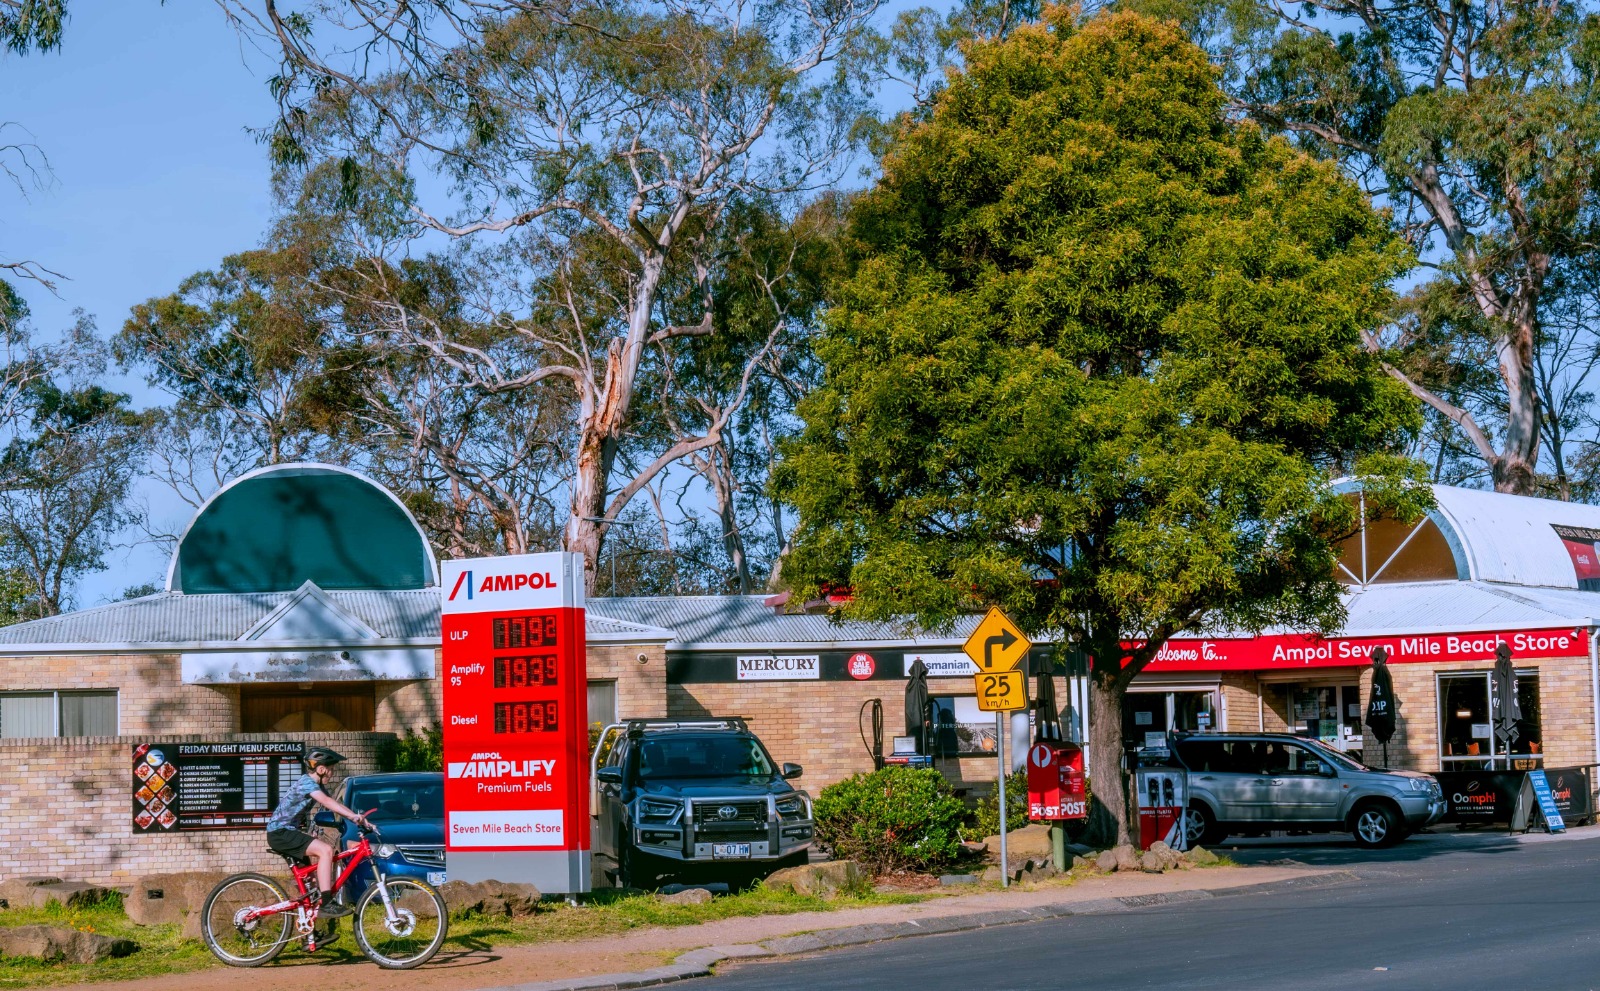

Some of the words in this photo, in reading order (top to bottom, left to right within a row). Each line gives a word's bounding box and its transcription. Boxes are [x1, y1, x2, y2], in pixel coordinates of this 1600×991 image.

[479, 572, 557, 593] AMPOL
[450, 630, 468, 640] ULP
[1149, 641, 1199, 663] elcome
[1272, 641, 1333, 664] Ampol
[1400, 638, 1441, 655] Mile
[1446, 635, 1506, 653] Beach
[1513, 632, 1570, 650] Store
[451, 663, 485, 675] Amplify
[740, 658, 816, 671] MERCURY
[853, 661, 870, 669] SALE
[451, 677, 462, 686] 95
[983, 675, 1011, 698] 25
[985, 699, 1010, 708] km/h
[451, 715, 478, 725] Diesel
[179, 745, 210, 753] FRIDAY
[212, 745, 238, 753] NIGHT
[239, 744, 263, 752] MENU
[264, 744, 302, 752] SPECIALS
[471, 752, 502, 760] AMPOL
[462, 760, 556, 778] AMPLIFY
[477, 782, 522, 793] Premium
[525, 781, 552, 792] Fuels
[1453, 791, 1496, 806] Oomph!
[1551, 788, 1571, 801] Oomph!
[1031, 806, 1059, 817] POST
[1061, 801, 1085, 816] POST
[453, 824, 480, 834] Seven
[482, 824, 502, 833] Mile
[504, 824, 533, 833] Beach
[535, 823, 561, 833] Store
